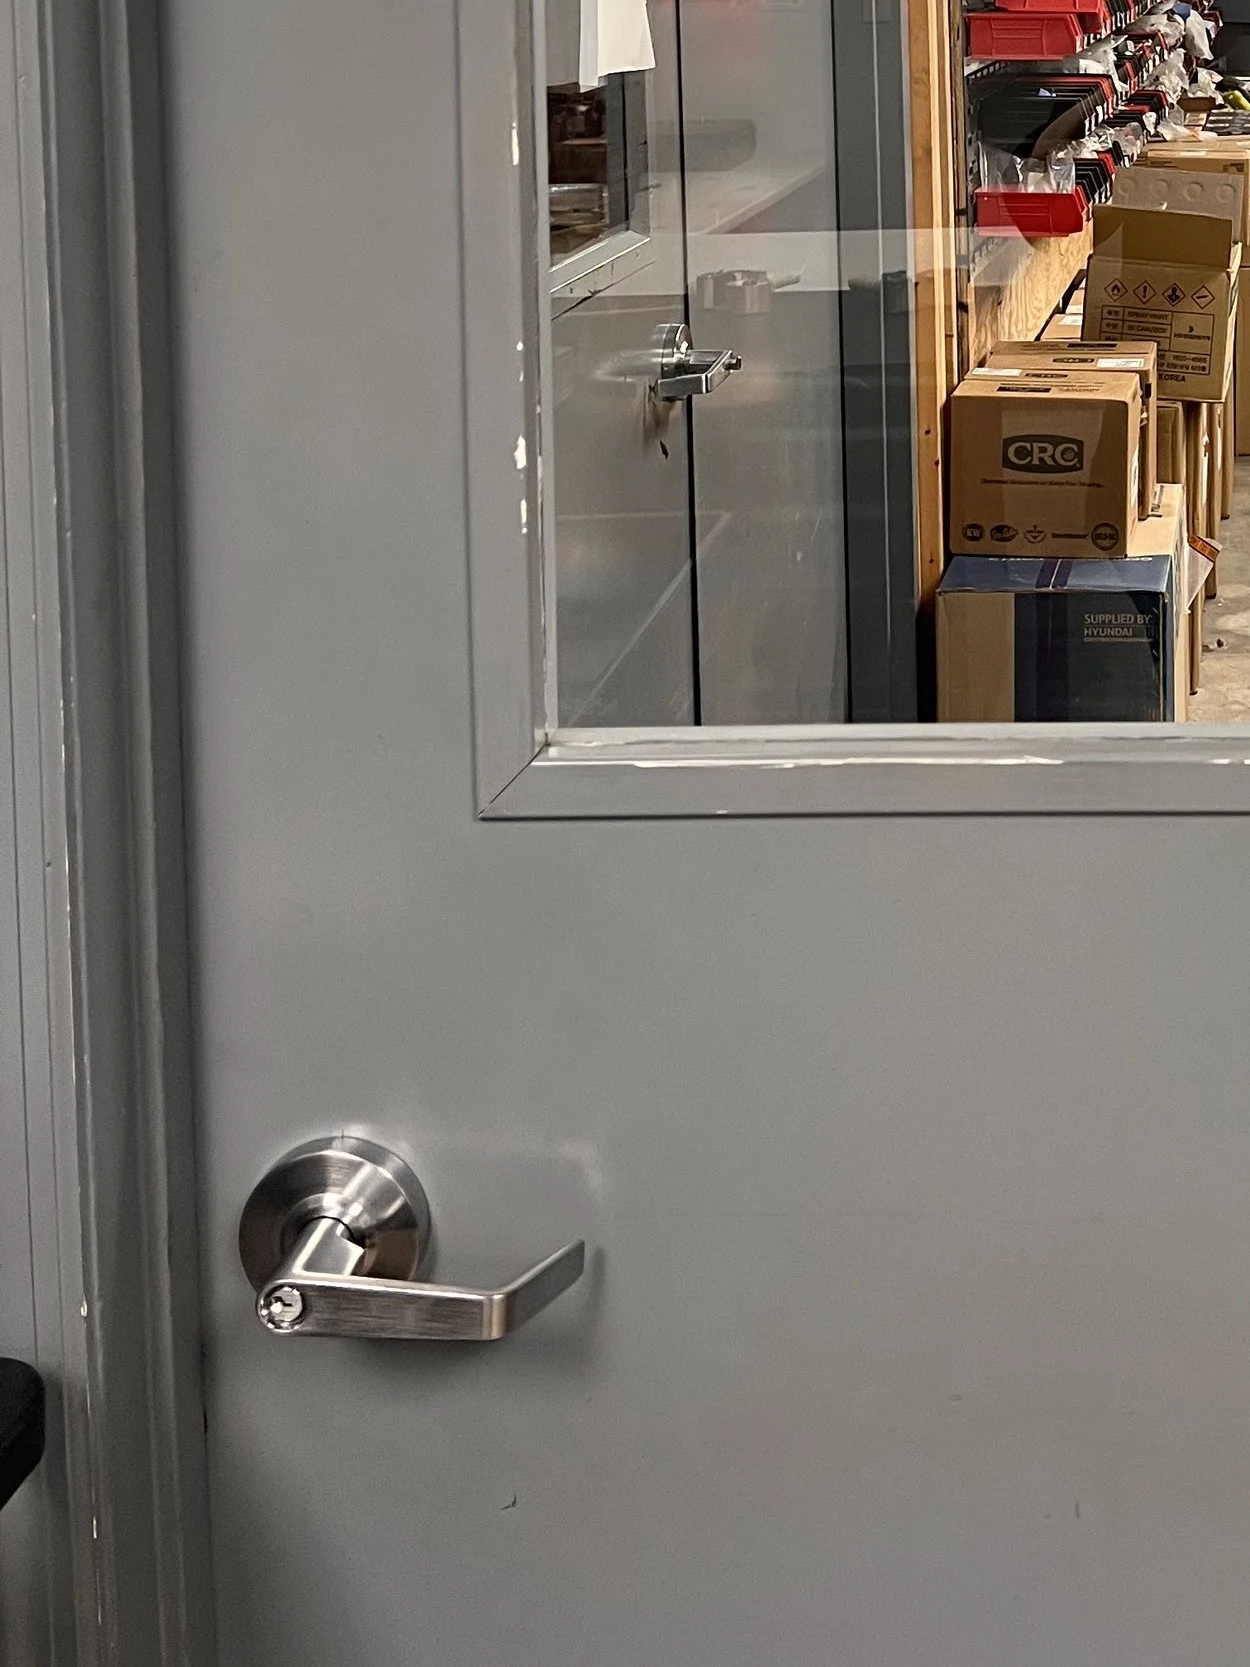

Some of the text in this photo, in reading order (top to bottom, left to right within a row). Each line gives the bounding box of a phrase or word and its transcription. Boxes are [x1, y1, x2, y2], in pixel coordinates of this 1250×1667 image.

[1159, 373, 1186, 383] KOREA
[1007, 442, 1079, 466] CRC
[1084, 613, 1152, 624] SUPPLIED BY
[1084, 627, 1133, 637] HYUNDAI
